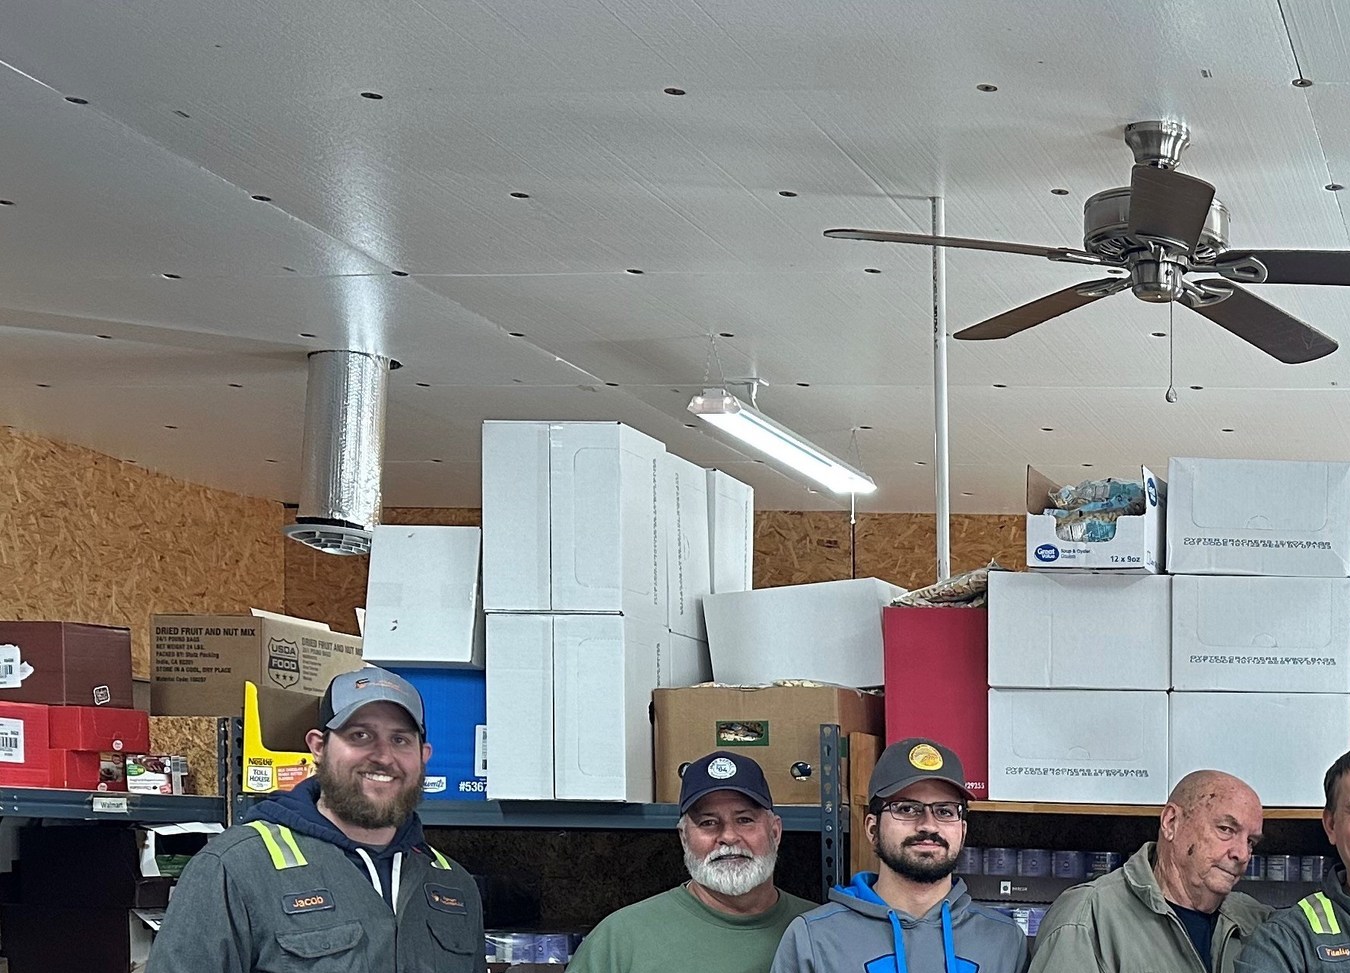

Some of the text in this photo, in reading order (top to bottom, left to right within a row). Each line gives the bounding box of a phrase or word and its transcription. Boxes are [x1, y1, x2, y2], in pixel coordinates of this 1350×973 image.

[1037, 547, 1056, 556] Great
[155, 627, 256, 637] DRIED FRUIT AND NUT MIX
[271, 643, 296, 655] USDA
[271, 661, 297, 670] FOOD
[100, 801, 124, 809] Walmart
[293, 895, 324, 908] Jacob
